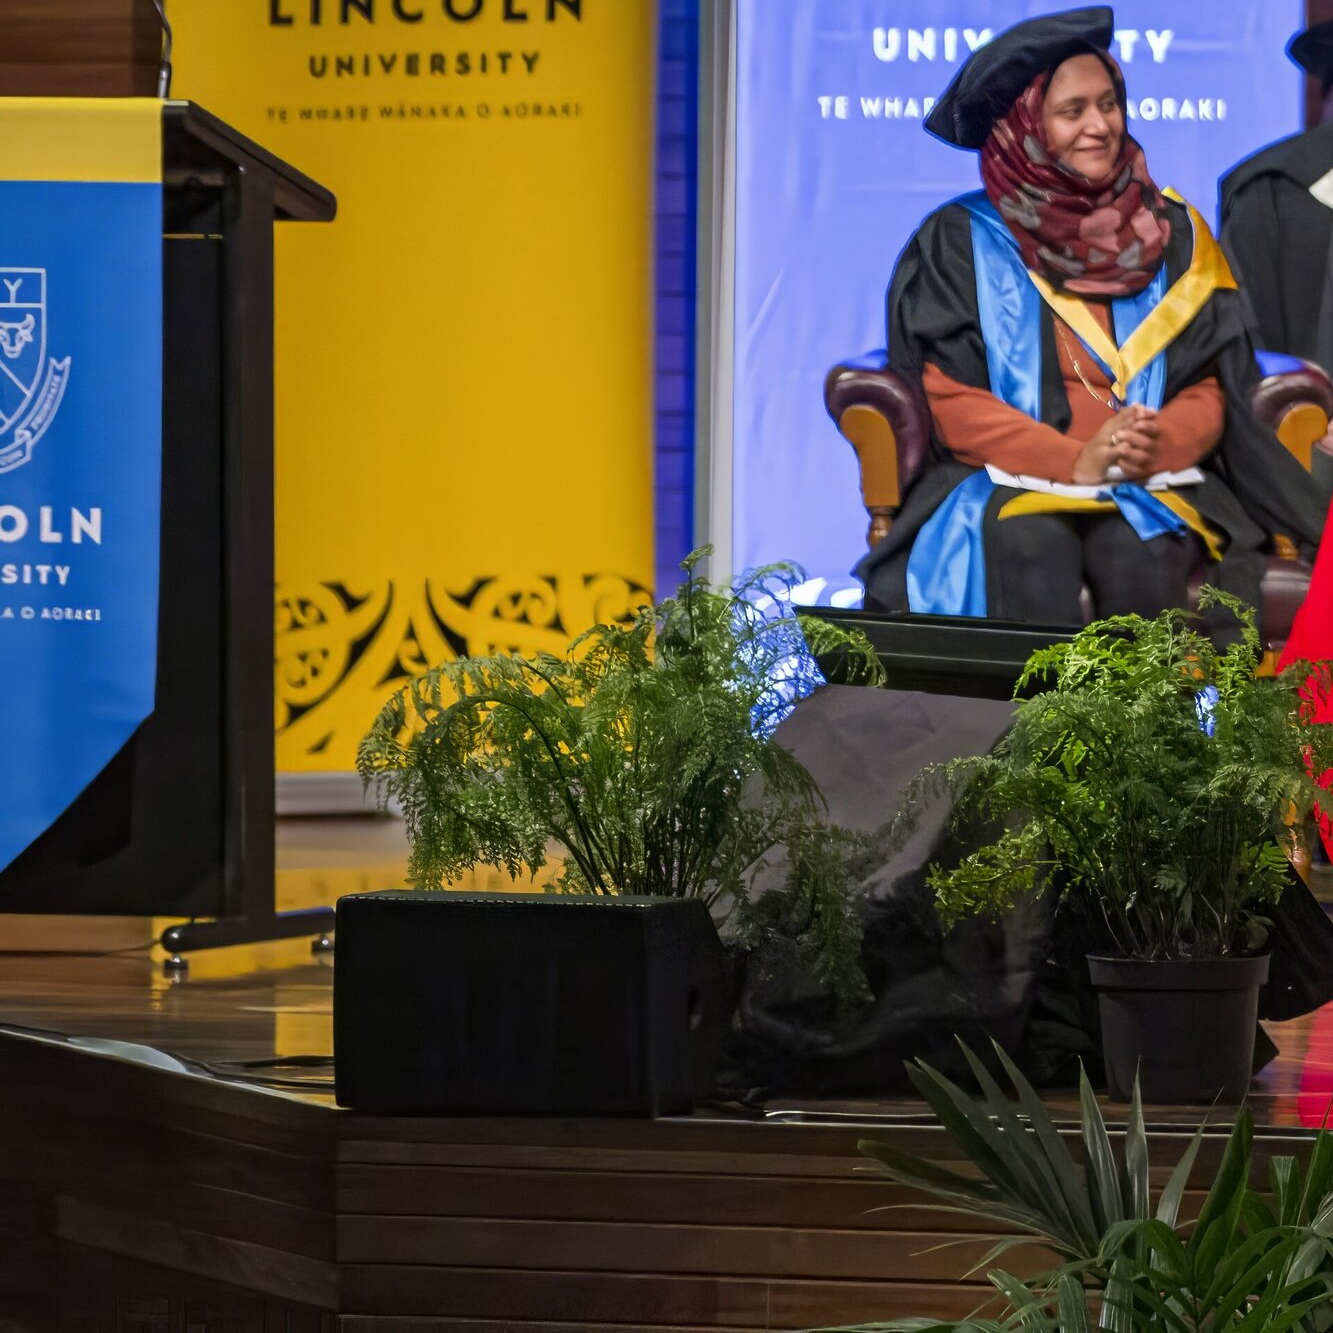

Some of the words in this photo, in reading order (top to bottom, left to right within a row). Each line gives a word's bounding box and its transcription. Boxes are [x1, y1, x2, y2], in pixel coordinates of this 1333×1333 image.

[873, 27, 1174, 63] UNIVTY
[309, 52, 539, 78] UNIVERSITY
[818, 96, 848, 119] TE
